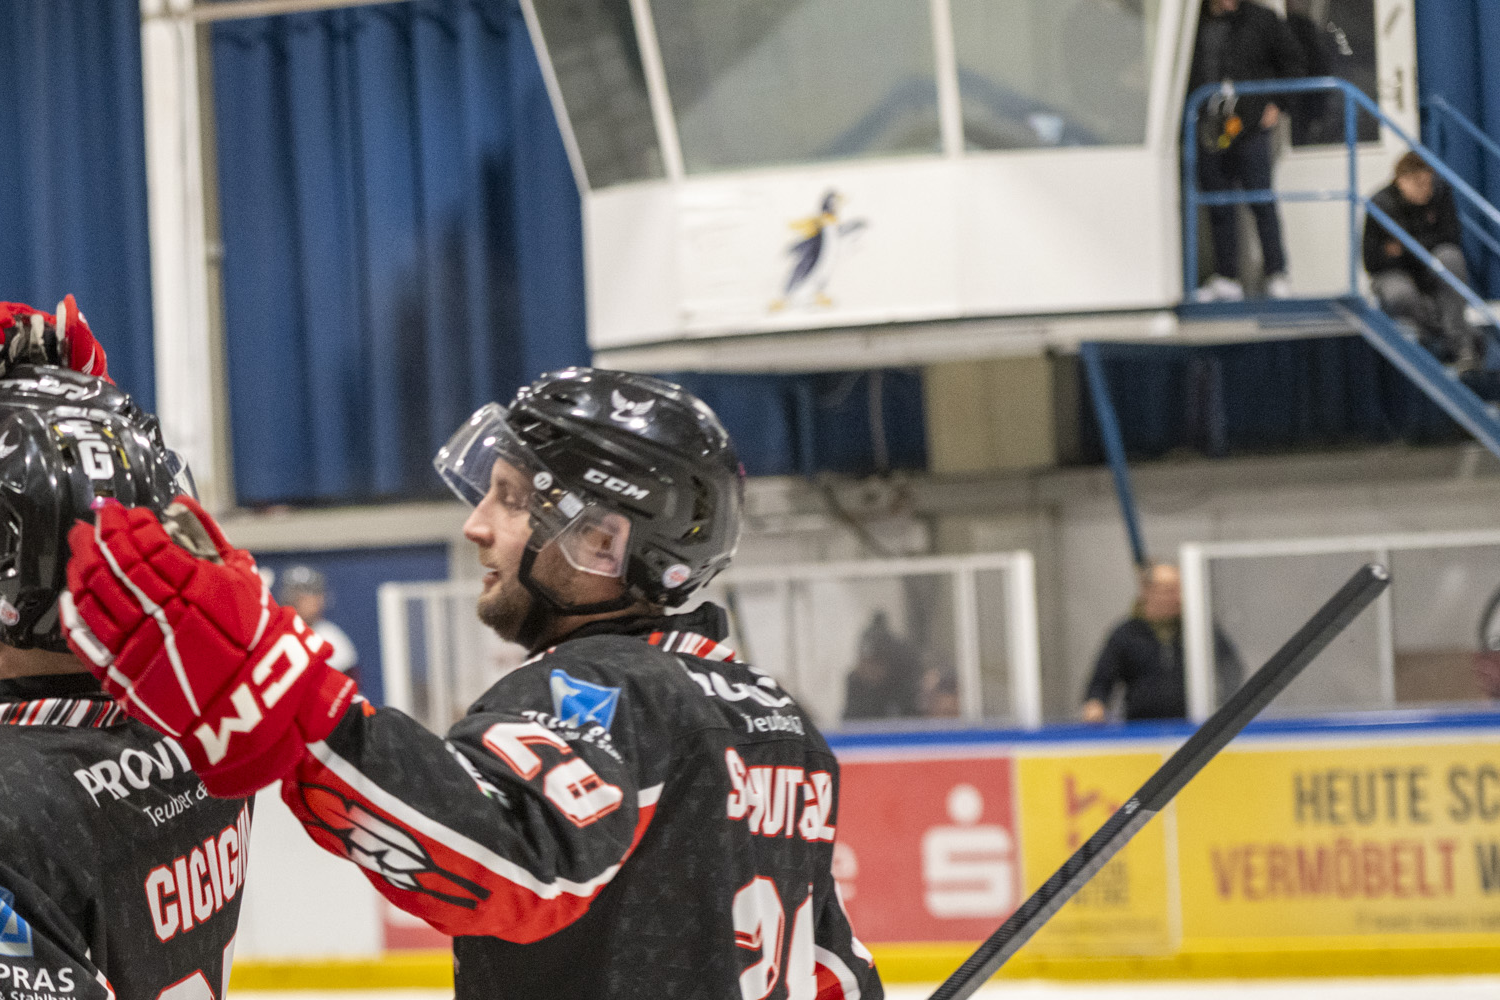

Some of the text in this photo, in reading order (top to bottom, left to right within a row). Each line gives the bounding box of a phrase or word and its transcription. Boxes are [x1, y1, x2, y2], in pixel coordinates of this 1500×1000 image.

[583, 468, 650, 500] CCM
[143, 789, 193, 827] Teuber
[1292, 766, 1431, 827] HEUTE
[1209, 836, 1457, 903] VERMÖBELT
